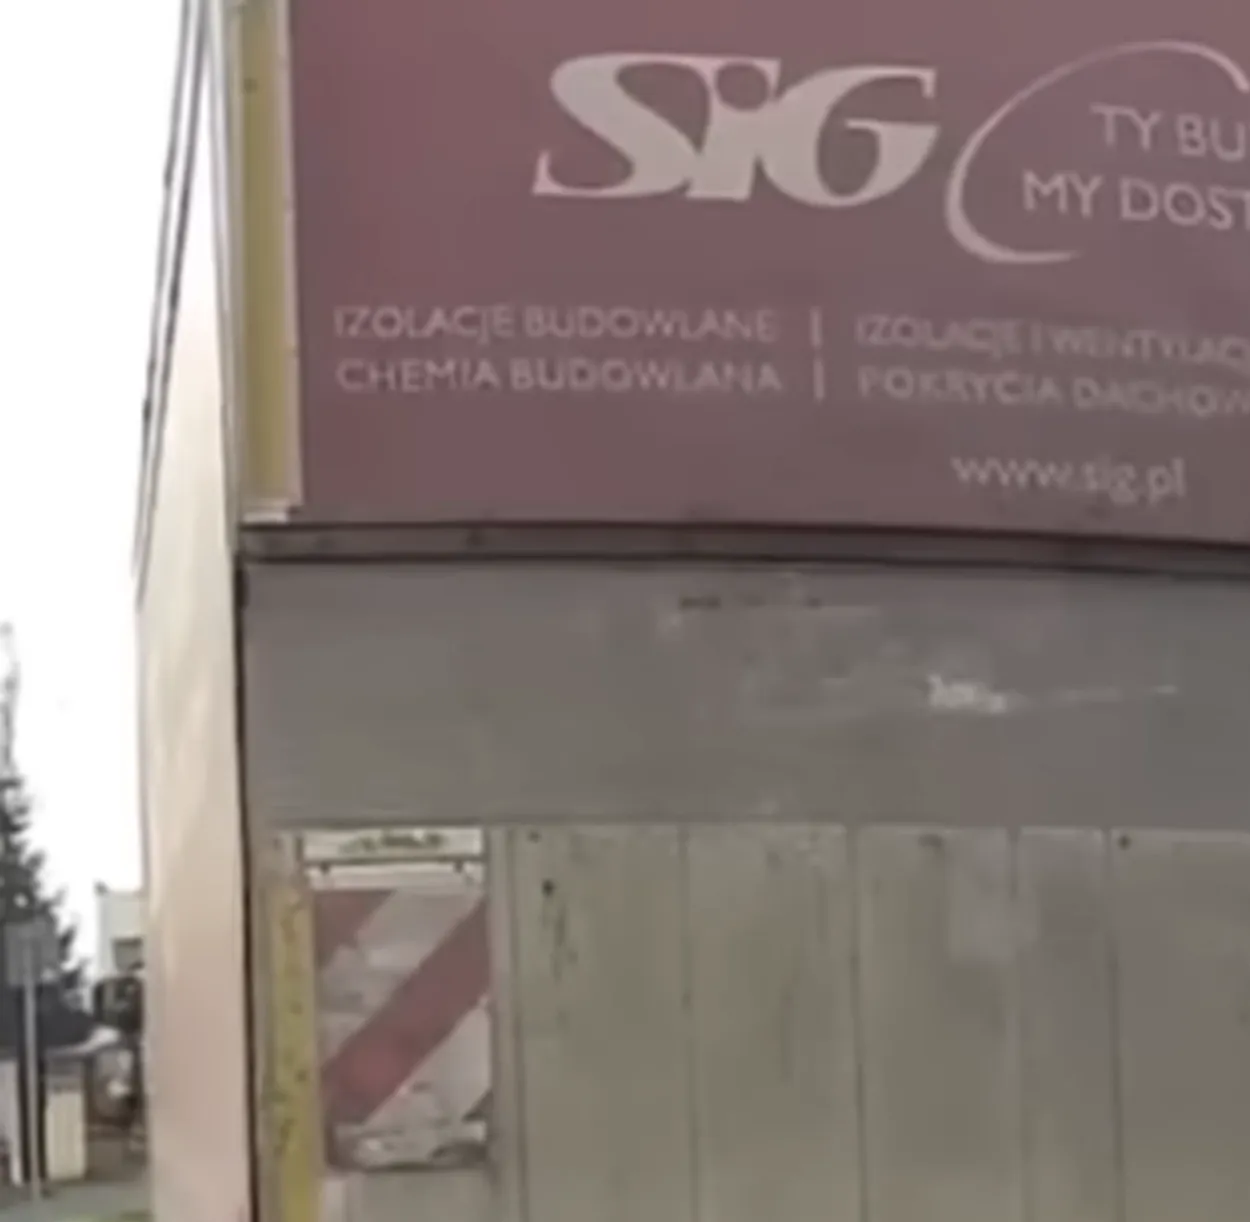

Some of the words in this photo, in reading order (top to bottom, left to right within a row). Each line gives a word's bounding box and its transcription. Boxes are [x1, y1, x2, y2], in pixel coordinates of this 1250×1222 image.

[1089, 102, 1162, 152] TY
[1022, 170, 1102, 217] MY
[333, 304, 514, 346] IZOLACJE
[524, 305, 781, 344] BUDOWLANE
[335, 356, 501, 394] CHEMIA
[510, 358, 783, 394] BUDOWLANA
[857, 365, 1063, 408] POKRYCIA
